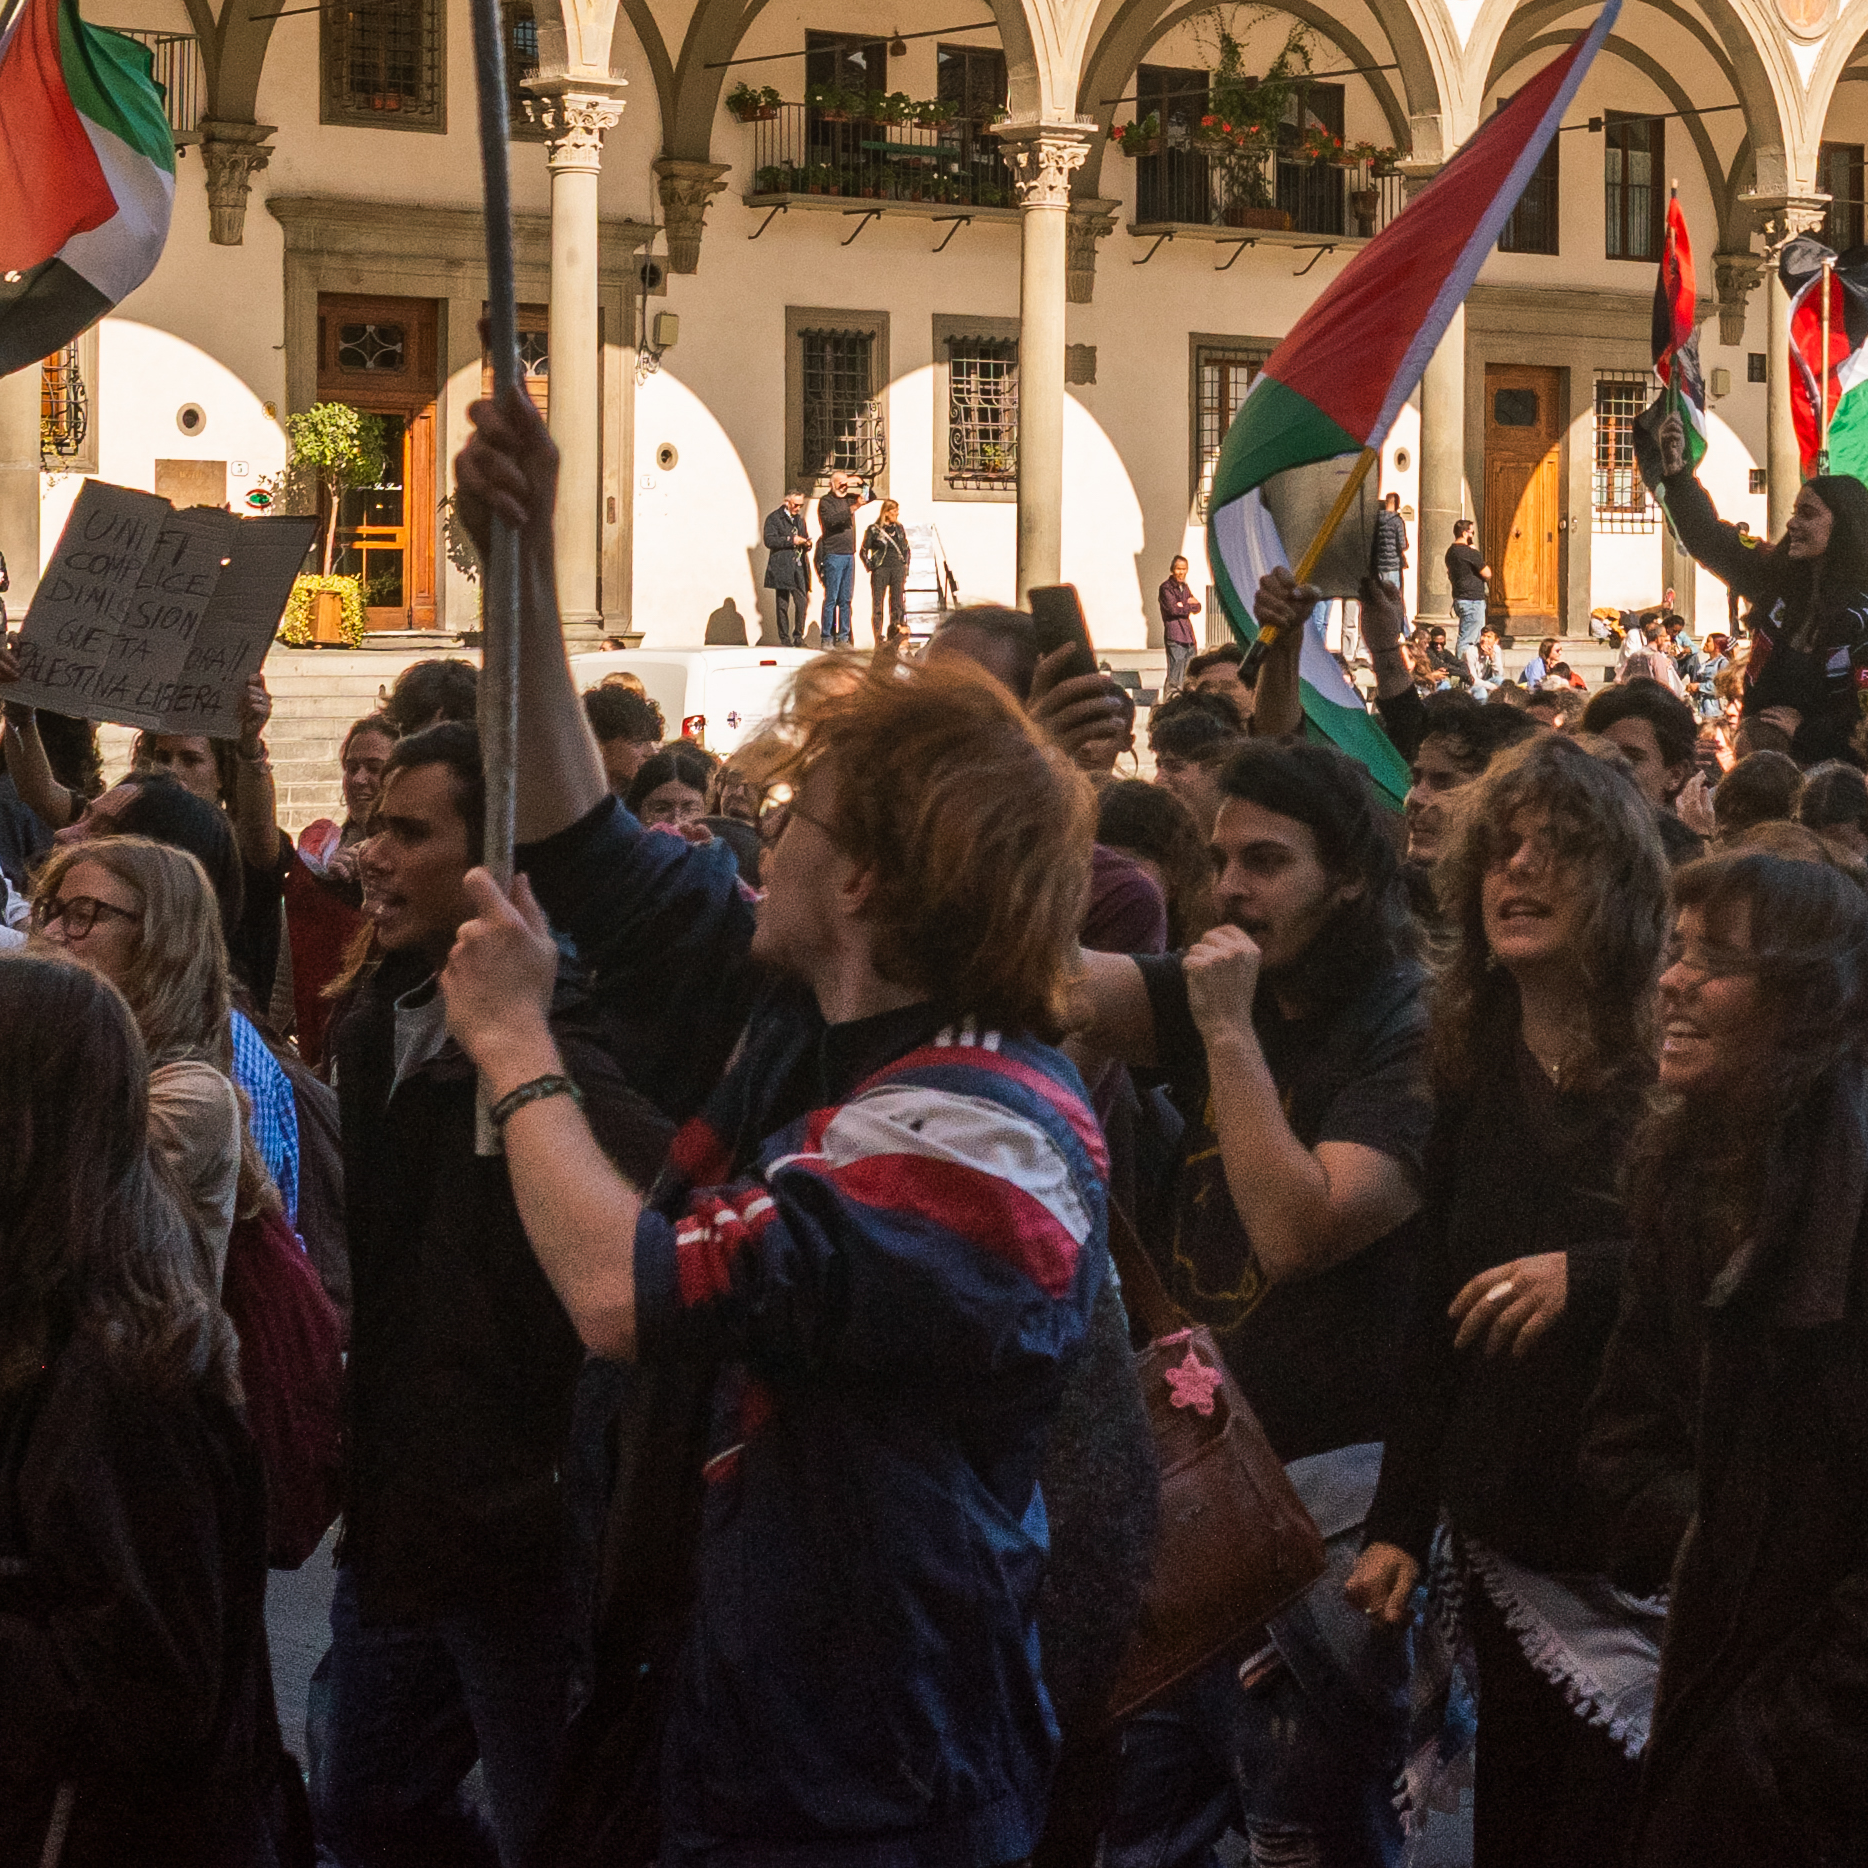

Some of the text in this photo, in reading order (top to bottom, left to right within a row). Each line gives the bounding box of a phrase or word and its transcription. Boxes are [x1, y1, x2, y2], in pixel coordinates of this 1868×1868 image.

[64, 551, 212, 598] COMPLICE
[16, 641, 223, 715] PALESTINA LIBERA
